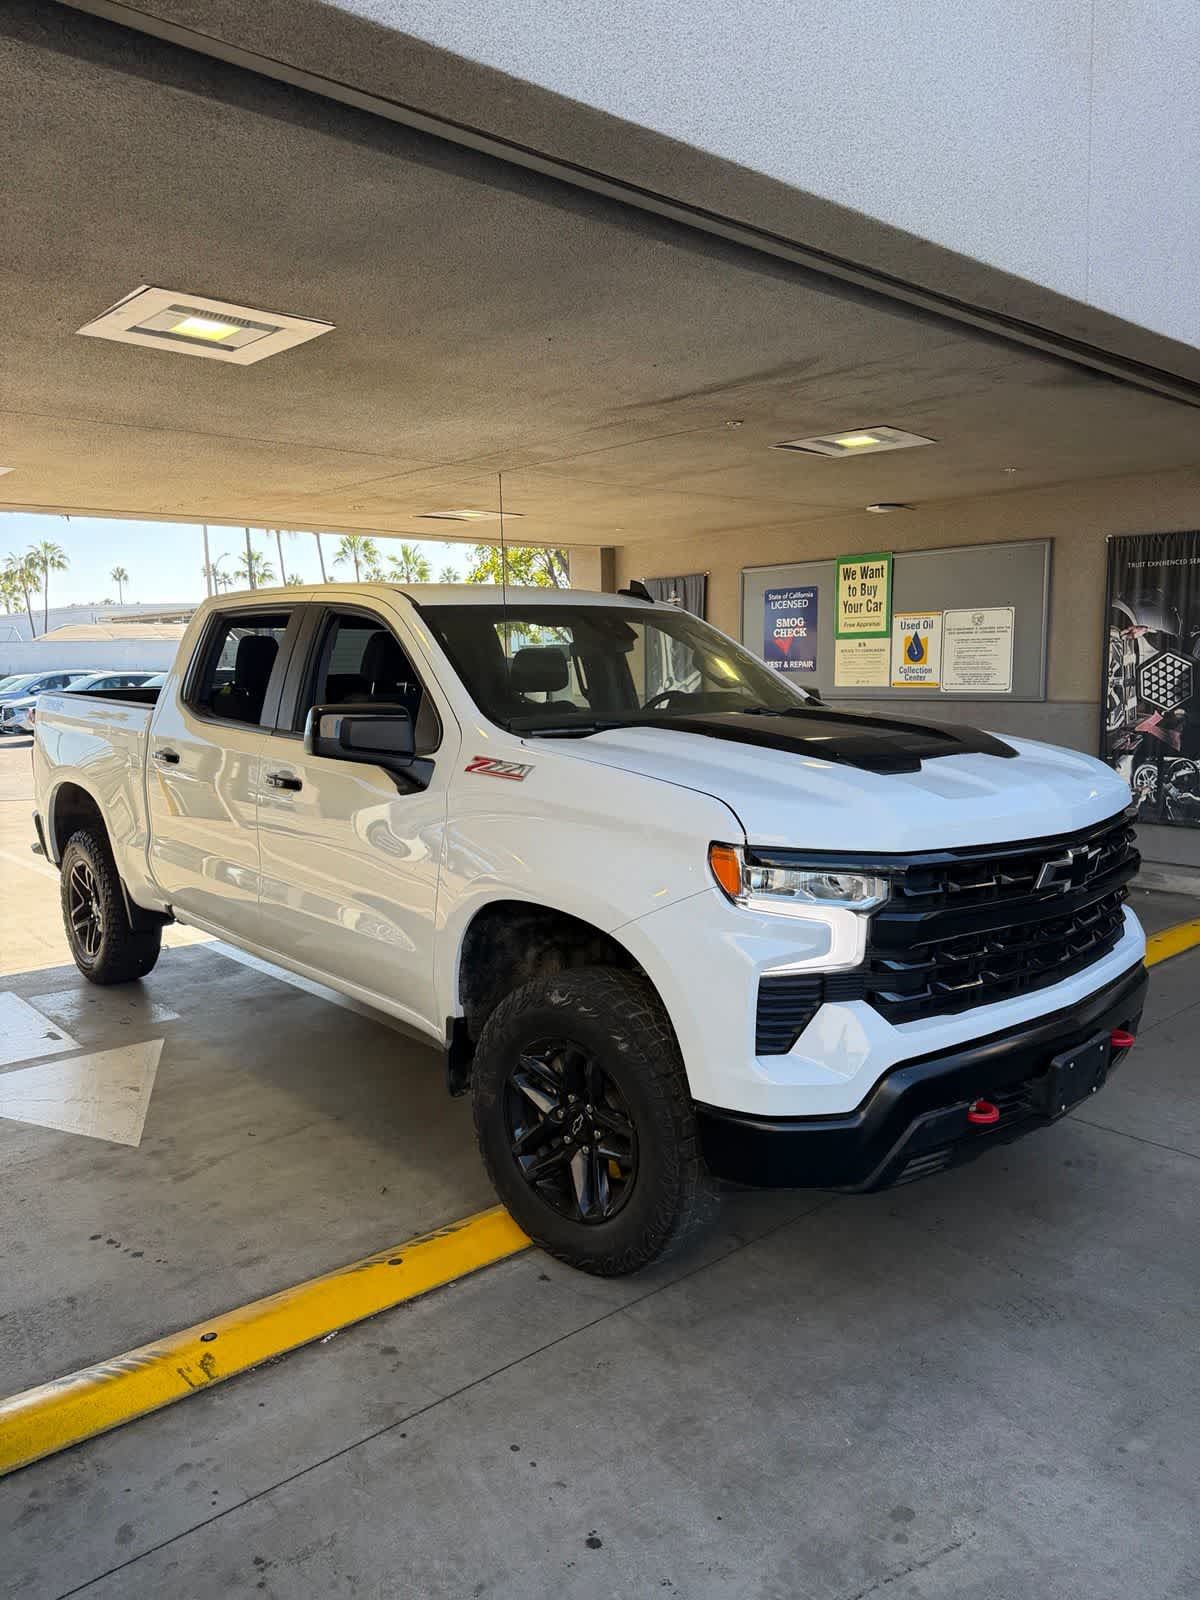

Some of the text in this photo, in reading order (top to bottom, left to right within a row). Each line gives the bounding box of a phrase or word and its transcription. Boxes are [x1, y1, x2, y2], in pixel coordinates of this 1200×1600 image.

[1147, 558, 1188, 567] EXPERIENCED
[843, 564, 885, 581] We Want
[768, 593, 782, 601] State
[788, 591, 814, 599] California
[848, 582, 878, 599] to Buy
[771, 599, 809, 610] LICENSED
[843, 599, 883, 615] Your Car
[776, 617, 805, 628] SMOG
[901, 619, 934, 630] Used Oil
[773, 627, 808, 638] CHECK
[789, 660, 814, 669] REPAIR
[899, 666, 932, 674] Collection
